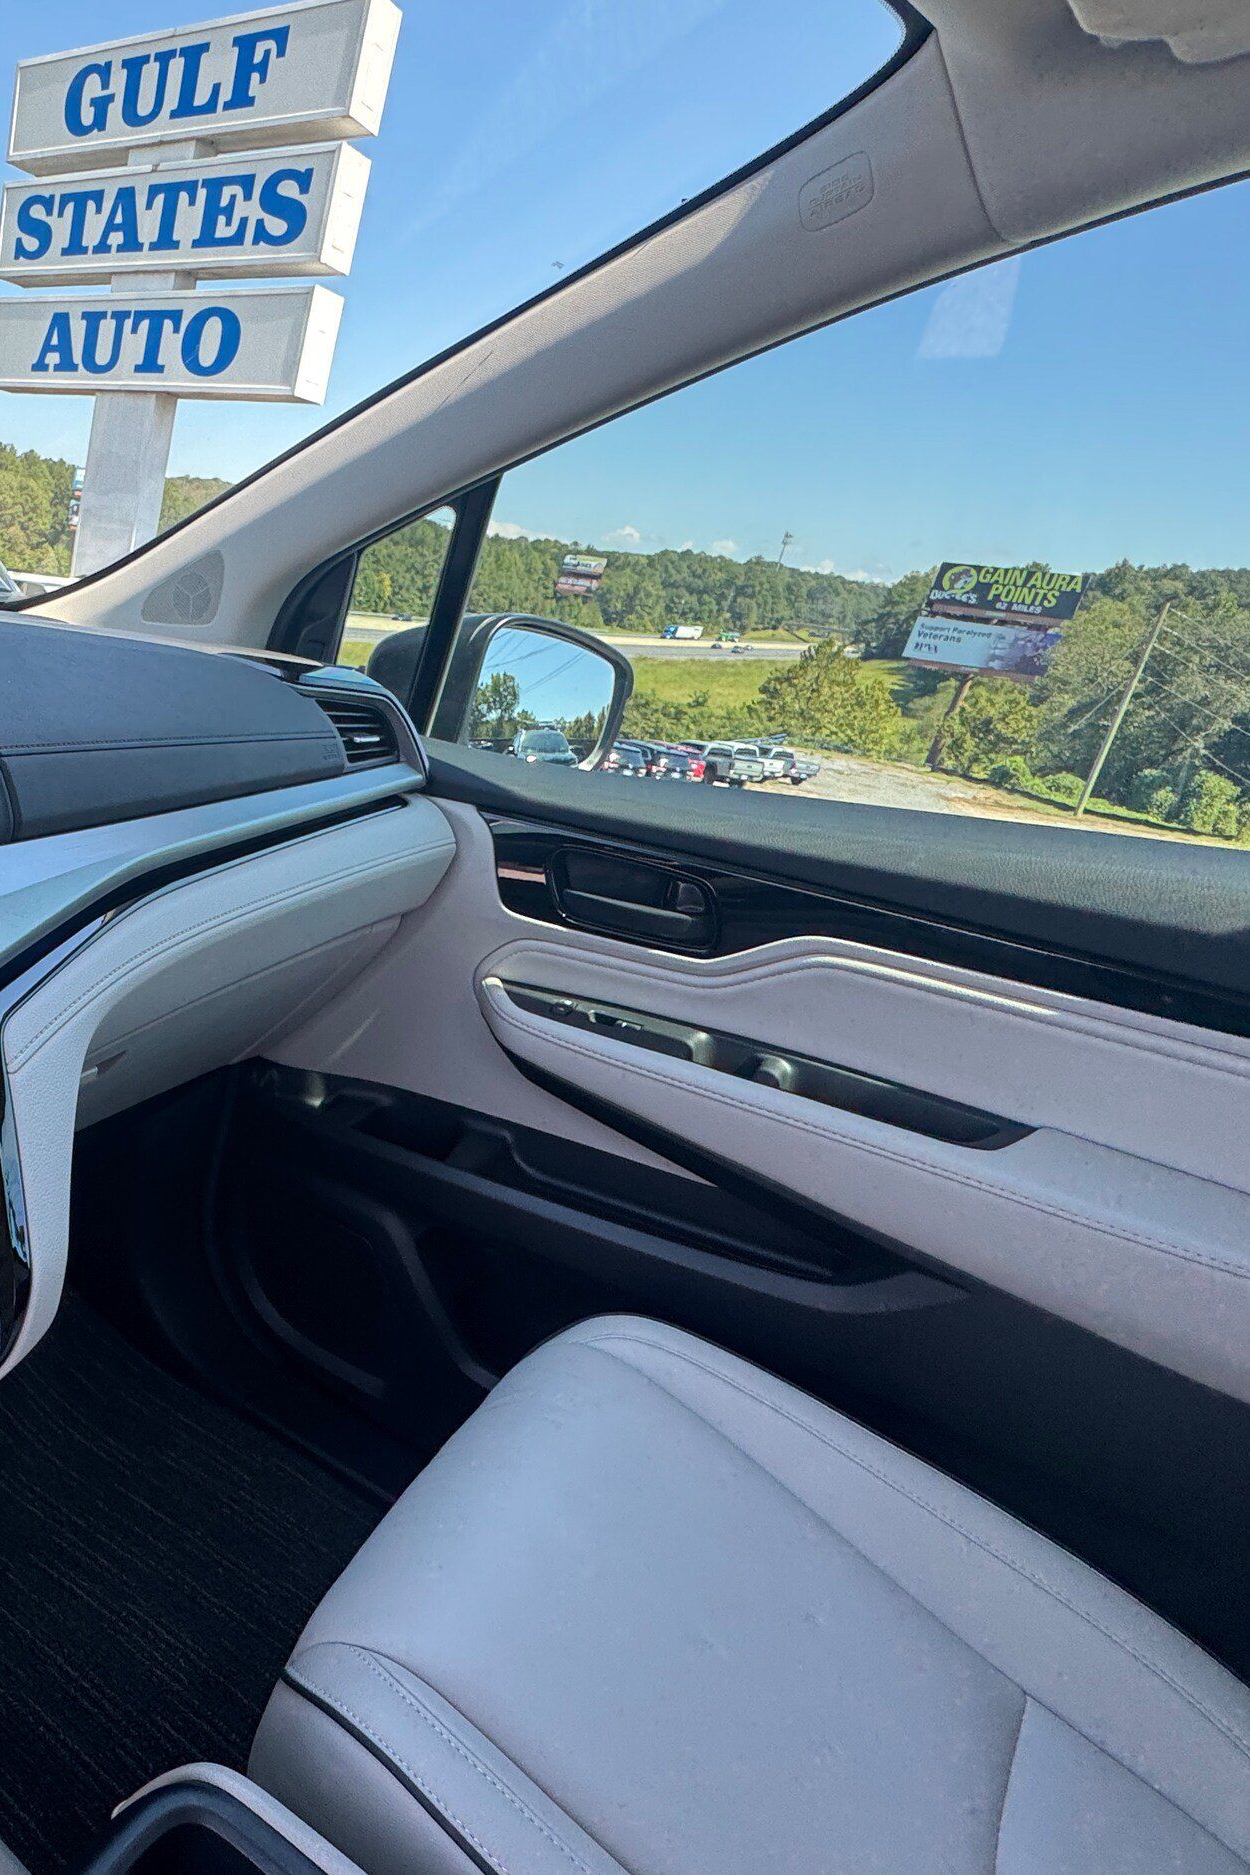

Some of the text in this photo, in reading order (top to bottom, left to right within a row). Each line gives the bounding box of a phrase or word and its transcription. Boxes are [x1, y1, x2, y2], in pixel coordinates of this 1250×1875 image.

[64, 25, 291, 137] GULF
[14, 167, 314, 260] STATES
[31, 306, 241, 377] AUTO
[978, 566, 1082, 593] GAIN AURA
[987, 584, 1061, 609] POINTS
[918, 630, 962, 643] Veterans
